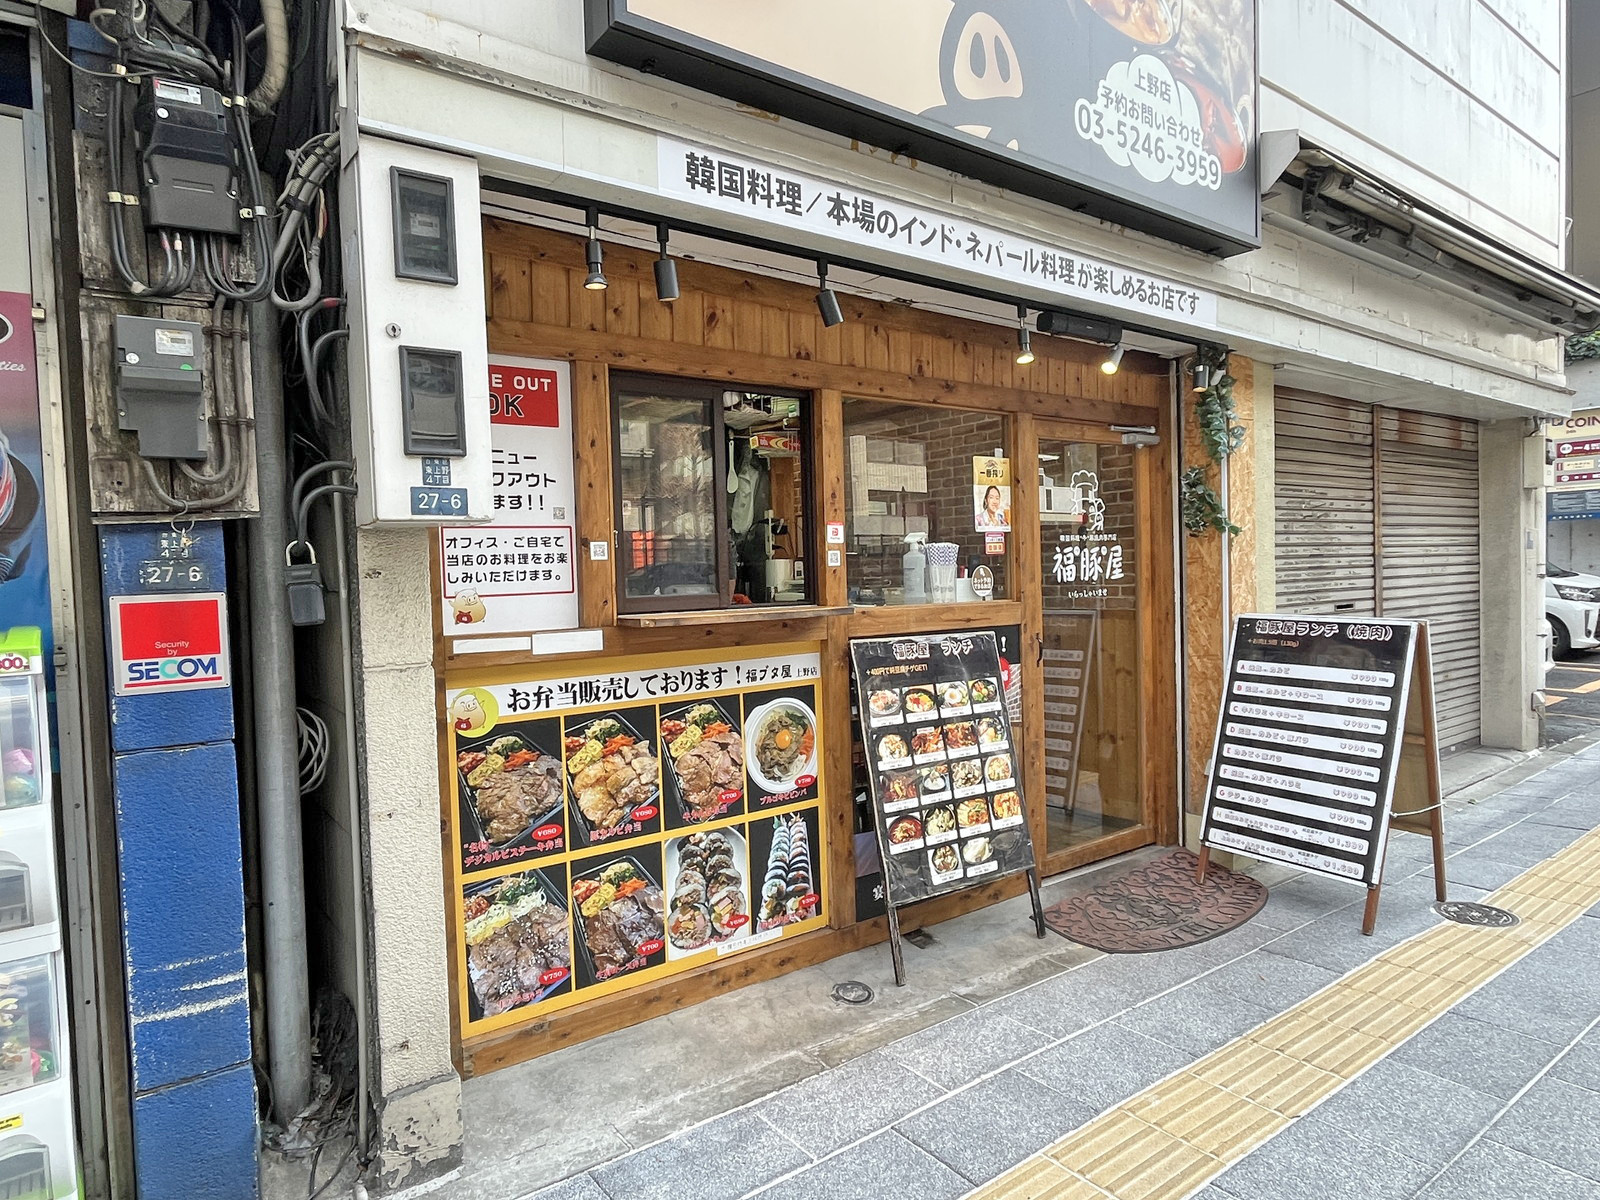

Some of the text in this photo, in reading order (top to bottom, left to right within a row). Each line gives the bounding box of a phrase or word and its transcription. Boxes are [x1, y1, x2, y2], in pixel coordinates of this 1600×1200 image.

[1134, 68, 1171, 104] 上野店
[1100, 85, 1201, 148] 予約お問い合わせ
[1078, 104, 1219, 186] 03-5246-3959
[513, 375, 551, 392] OUT
[418, 493, 462, 509] 27-6
[445, 535, 564, 550] オフィス・ご自宅で
[446, 552, 568, 567] 当店のお料理をお楽
[1052, 545, 1125, 583] 福豚屋
[147, 566, 203, 584] 27-6
[447, 570, 562, 584] しみいただけます。
[155, 641, 190, 649] Security
[167, 648, 178, 656] by
[892, 639, 974, 661] 福豚屋 ランチ
[128, 657, 217, 682] SECOM
[745, 664, 793, 684] 福ブタ屋
[795, 666, 818, 679] 上野店
[543, 970, 563, 981] ¥750
